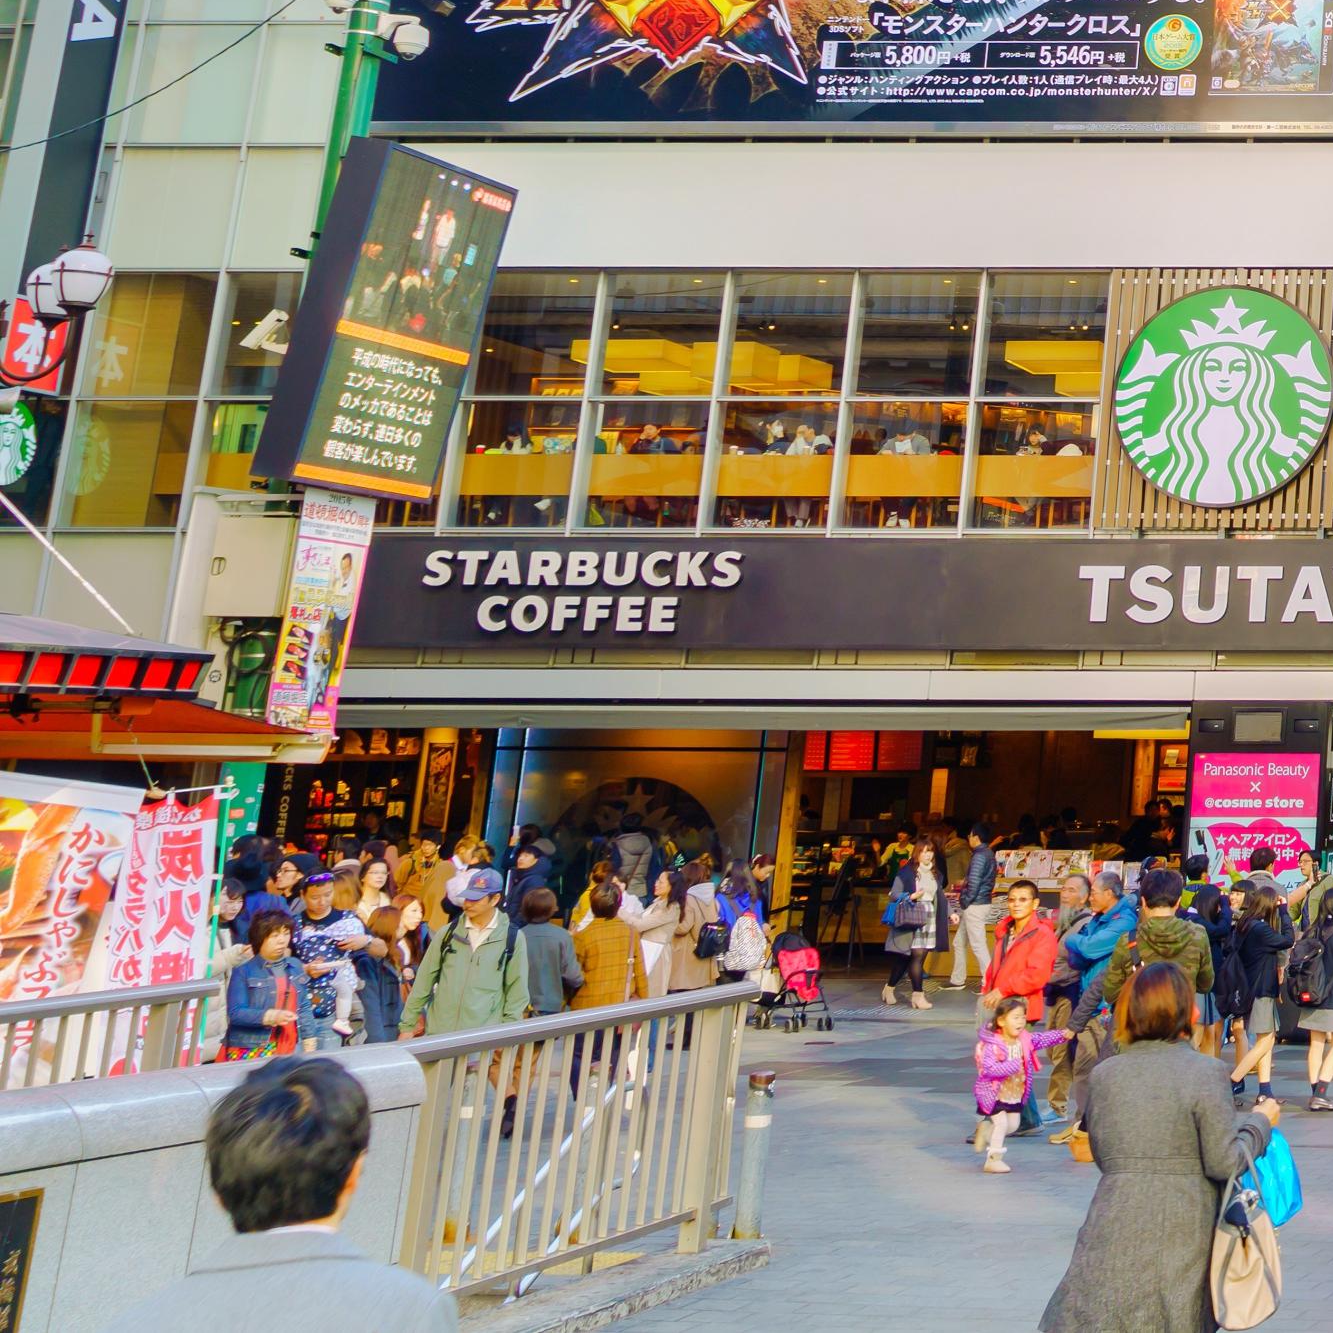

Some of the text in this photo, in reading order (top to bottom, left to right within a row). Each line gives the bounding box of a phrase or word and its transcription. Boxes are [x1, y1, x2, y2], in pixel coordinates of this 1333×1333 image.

[884, 45, 951, 67] 5,800円
[1039, 45, 1105, 67] 5,546円
[344, 372, 437, 406] エンターテインメント
[421, 550, 744, 591] STARBUCKS
[475, 596, 680, 634] COFFEE
[1203, 763, 1311, 779] Panasonic Beauty
[1204, 795, 1305, 809] @cosme store
[1228, 834, 1297, 846] ヘアアイロン
